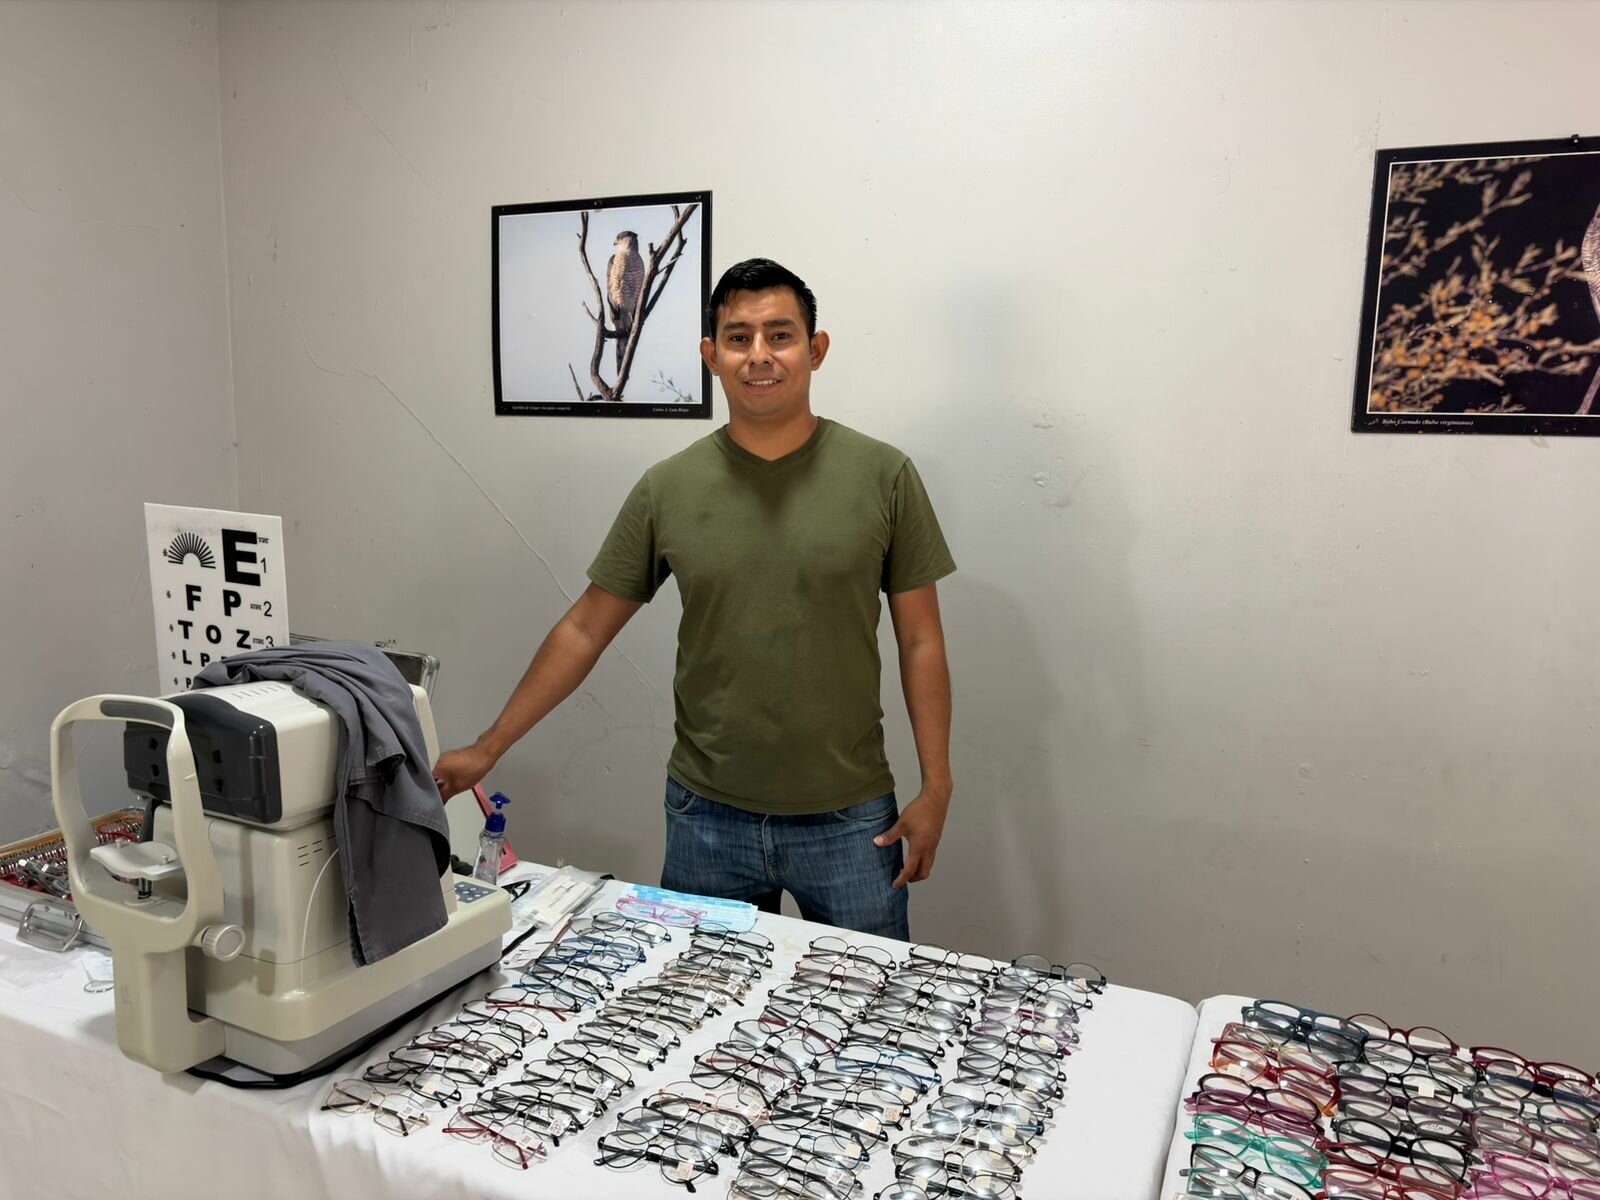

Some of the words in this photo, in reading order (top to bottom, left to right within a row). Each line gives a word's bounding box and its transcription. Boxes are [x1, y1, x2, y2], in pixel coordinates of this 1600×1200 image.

[222, 528, 261, 587] E
[260, 557, 267, 574] 1
[185, 584, 202, 612] F
[223, 589, 242, 617] P
[263, 600, 273, 618] 2
[177, 620, 193, 640] T
[205, 624, 222, 645] O
[236, 628, 252, 650] Z
[265, 635, 275, 649] 3
[182, 649, 193, 665] L
[200, 652, 211, 668] P
[185, 677, 192, 689] P
